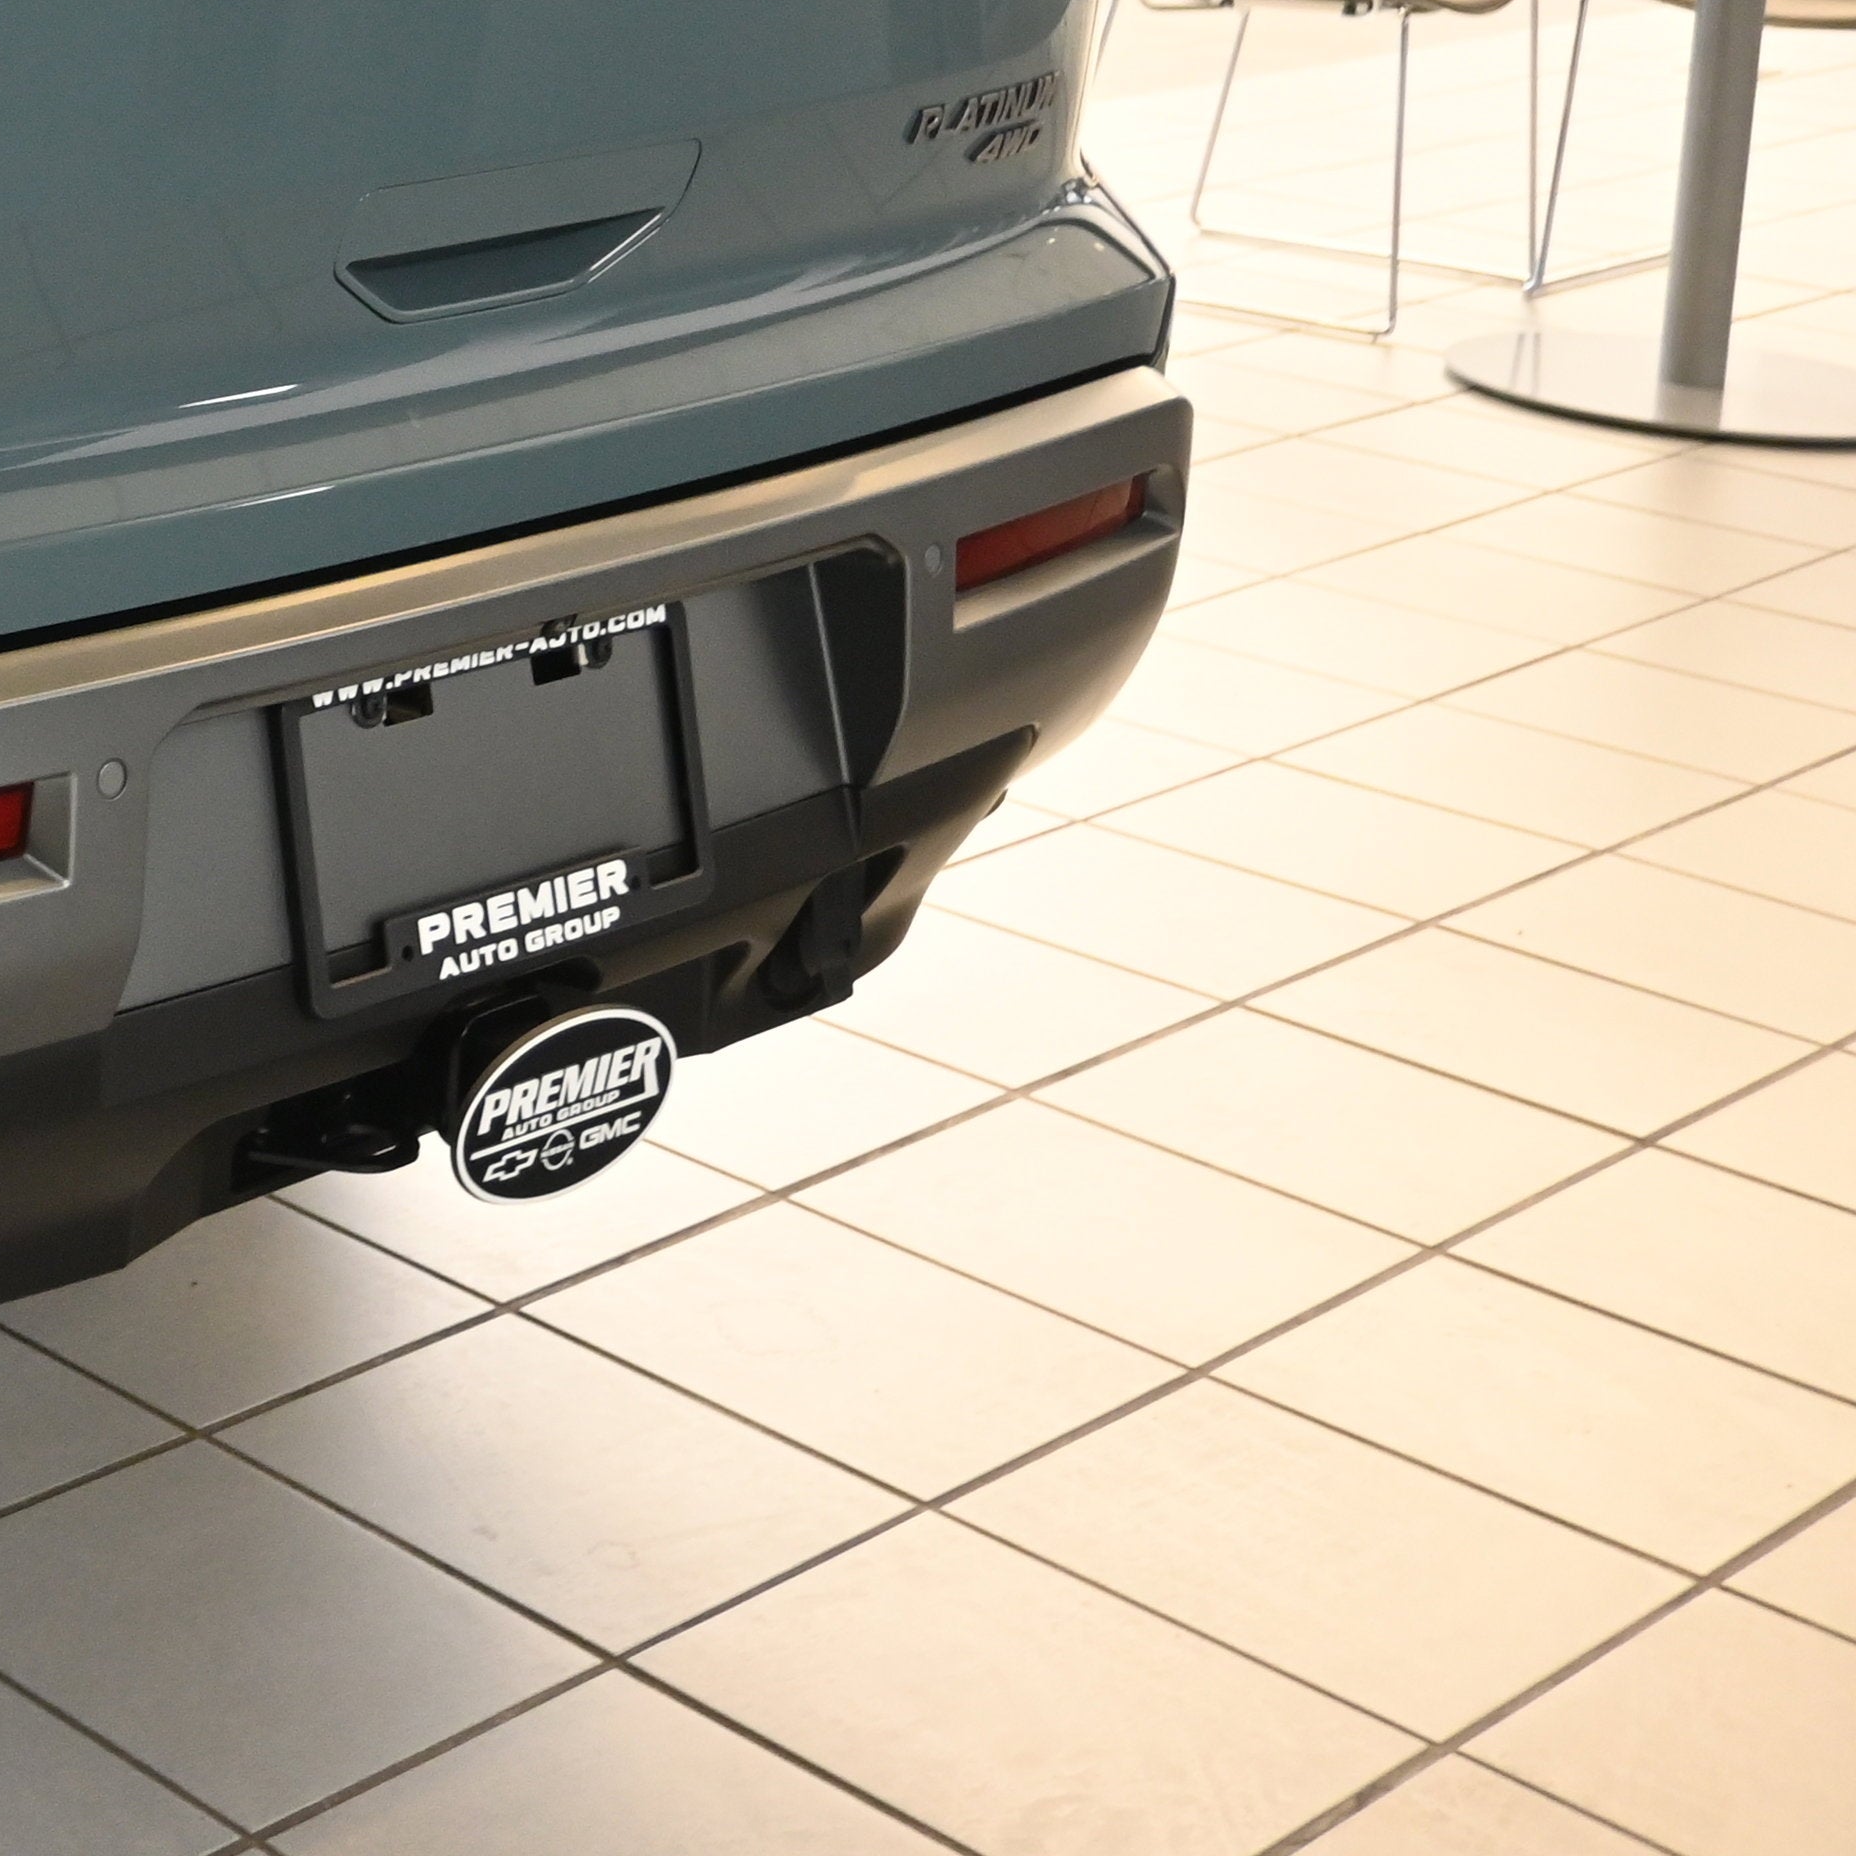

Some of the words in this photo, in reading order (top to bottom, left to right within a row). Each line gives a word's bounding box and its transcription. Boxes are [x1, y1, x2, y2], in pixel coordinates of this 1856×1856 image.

[902, 70, 1062, 147] PLATINUM
[416, 858, 630, 956] PREMIER
[438, 937, 519, 981] AUTO
[523, 905, 621, 953] GROUP
[476, 1035, 663, 1137] PREMIER
[500, 1114, 553, 1142] AUTO
[555, 1089, 621, 1122] GROUP
[578, 1110, 643, 1151] GMC
